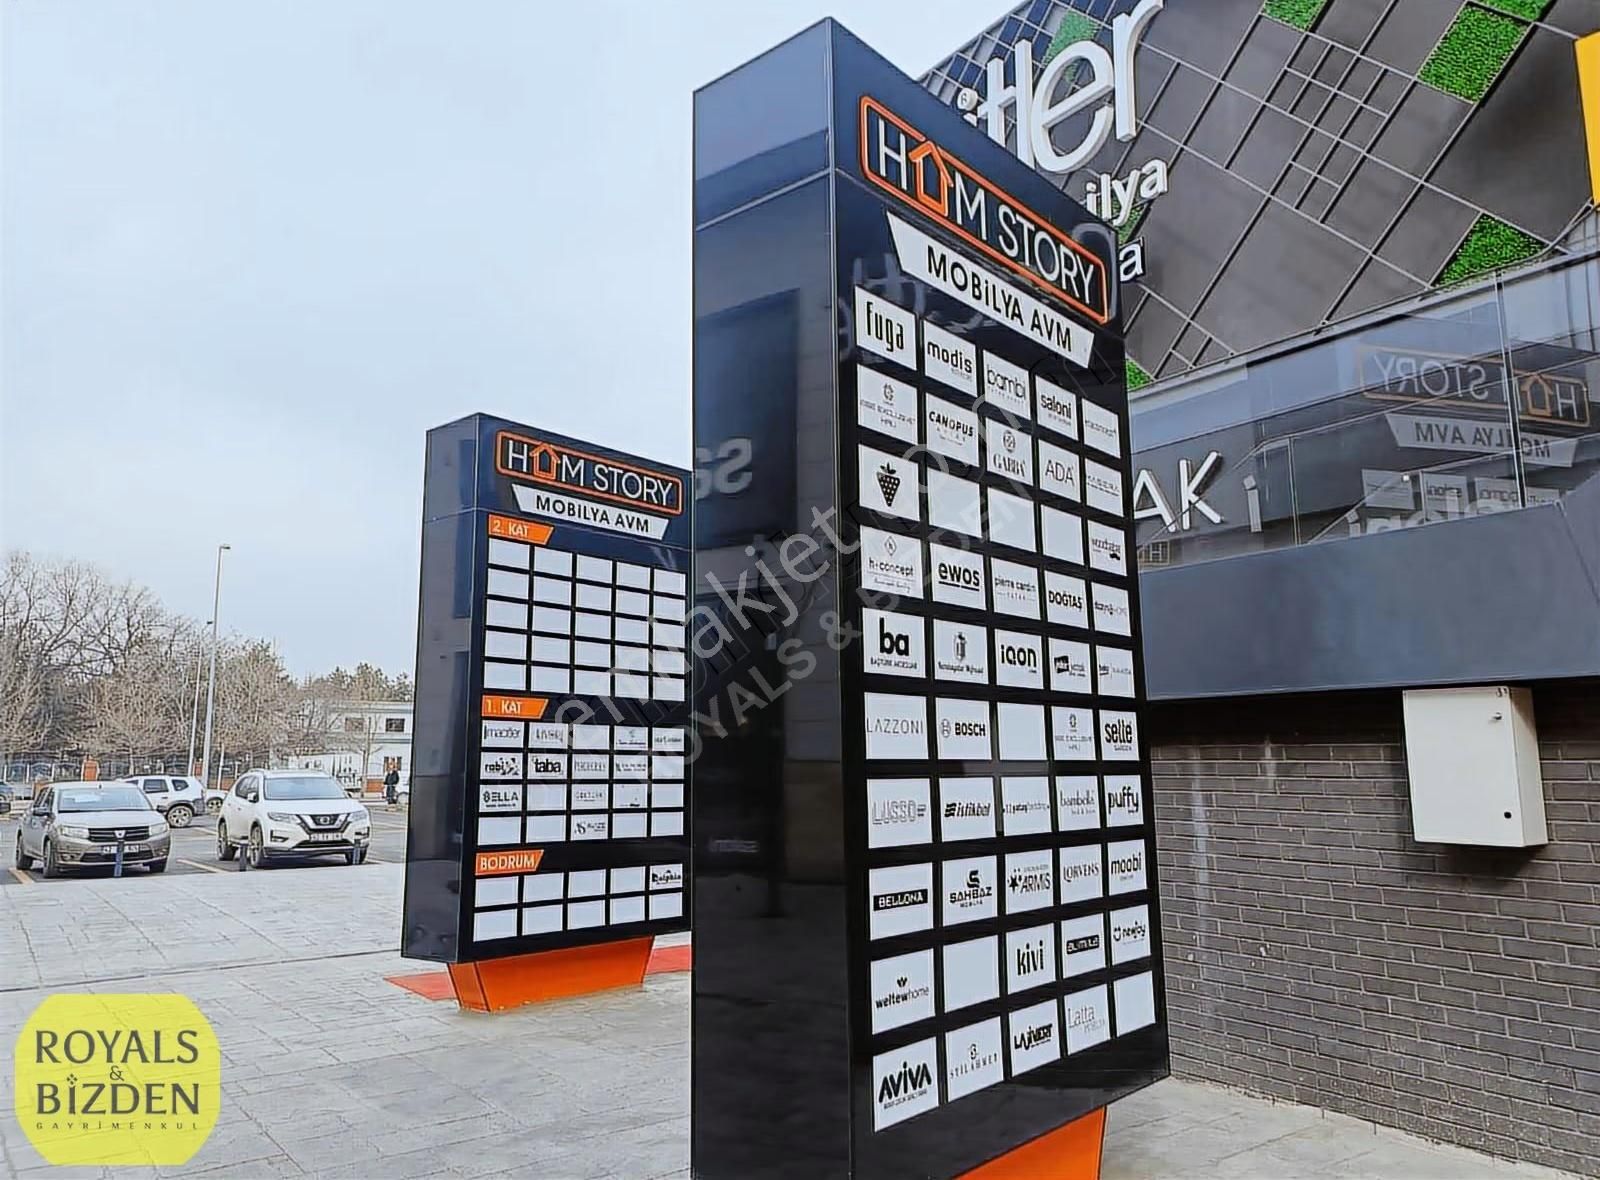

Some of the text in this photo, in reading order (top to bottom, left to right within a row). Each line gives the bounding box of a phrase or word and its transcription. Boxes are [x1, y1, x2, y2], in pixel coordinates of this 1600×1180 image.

[999, 204, 1095, 304] STORY
[1030, 304, 1072, 353] AVM
[927, 340, 973, 373] modis
[1041, 394, 1072, 420] saloni
[928, 410, 974, 437] CANOPUS
[593, 463, 673, 506] STORY
[492, 520, 530, 537] 2. KAT
[615, 515, 649, 533] AVM
[938, 561, 980, 587] ewos
[879, 617, 910, 658] ba
[486, 698, 522, 715] 1. KAT
[866, 717, 924, 735] LAZZONI
[954, 722, 986, 737] BOSCH
[1104, 719, 1133, 744] selle
[534, 758, 562, 773] taba
[956, 802, 991, 818] istikbal
[1108, 786, 1139, 815] puffy
[480, 855, 535, 870] BODRUM
[878, 891, 924, 908] BELLONA
[1016, 939, 1044, 976] kivi
